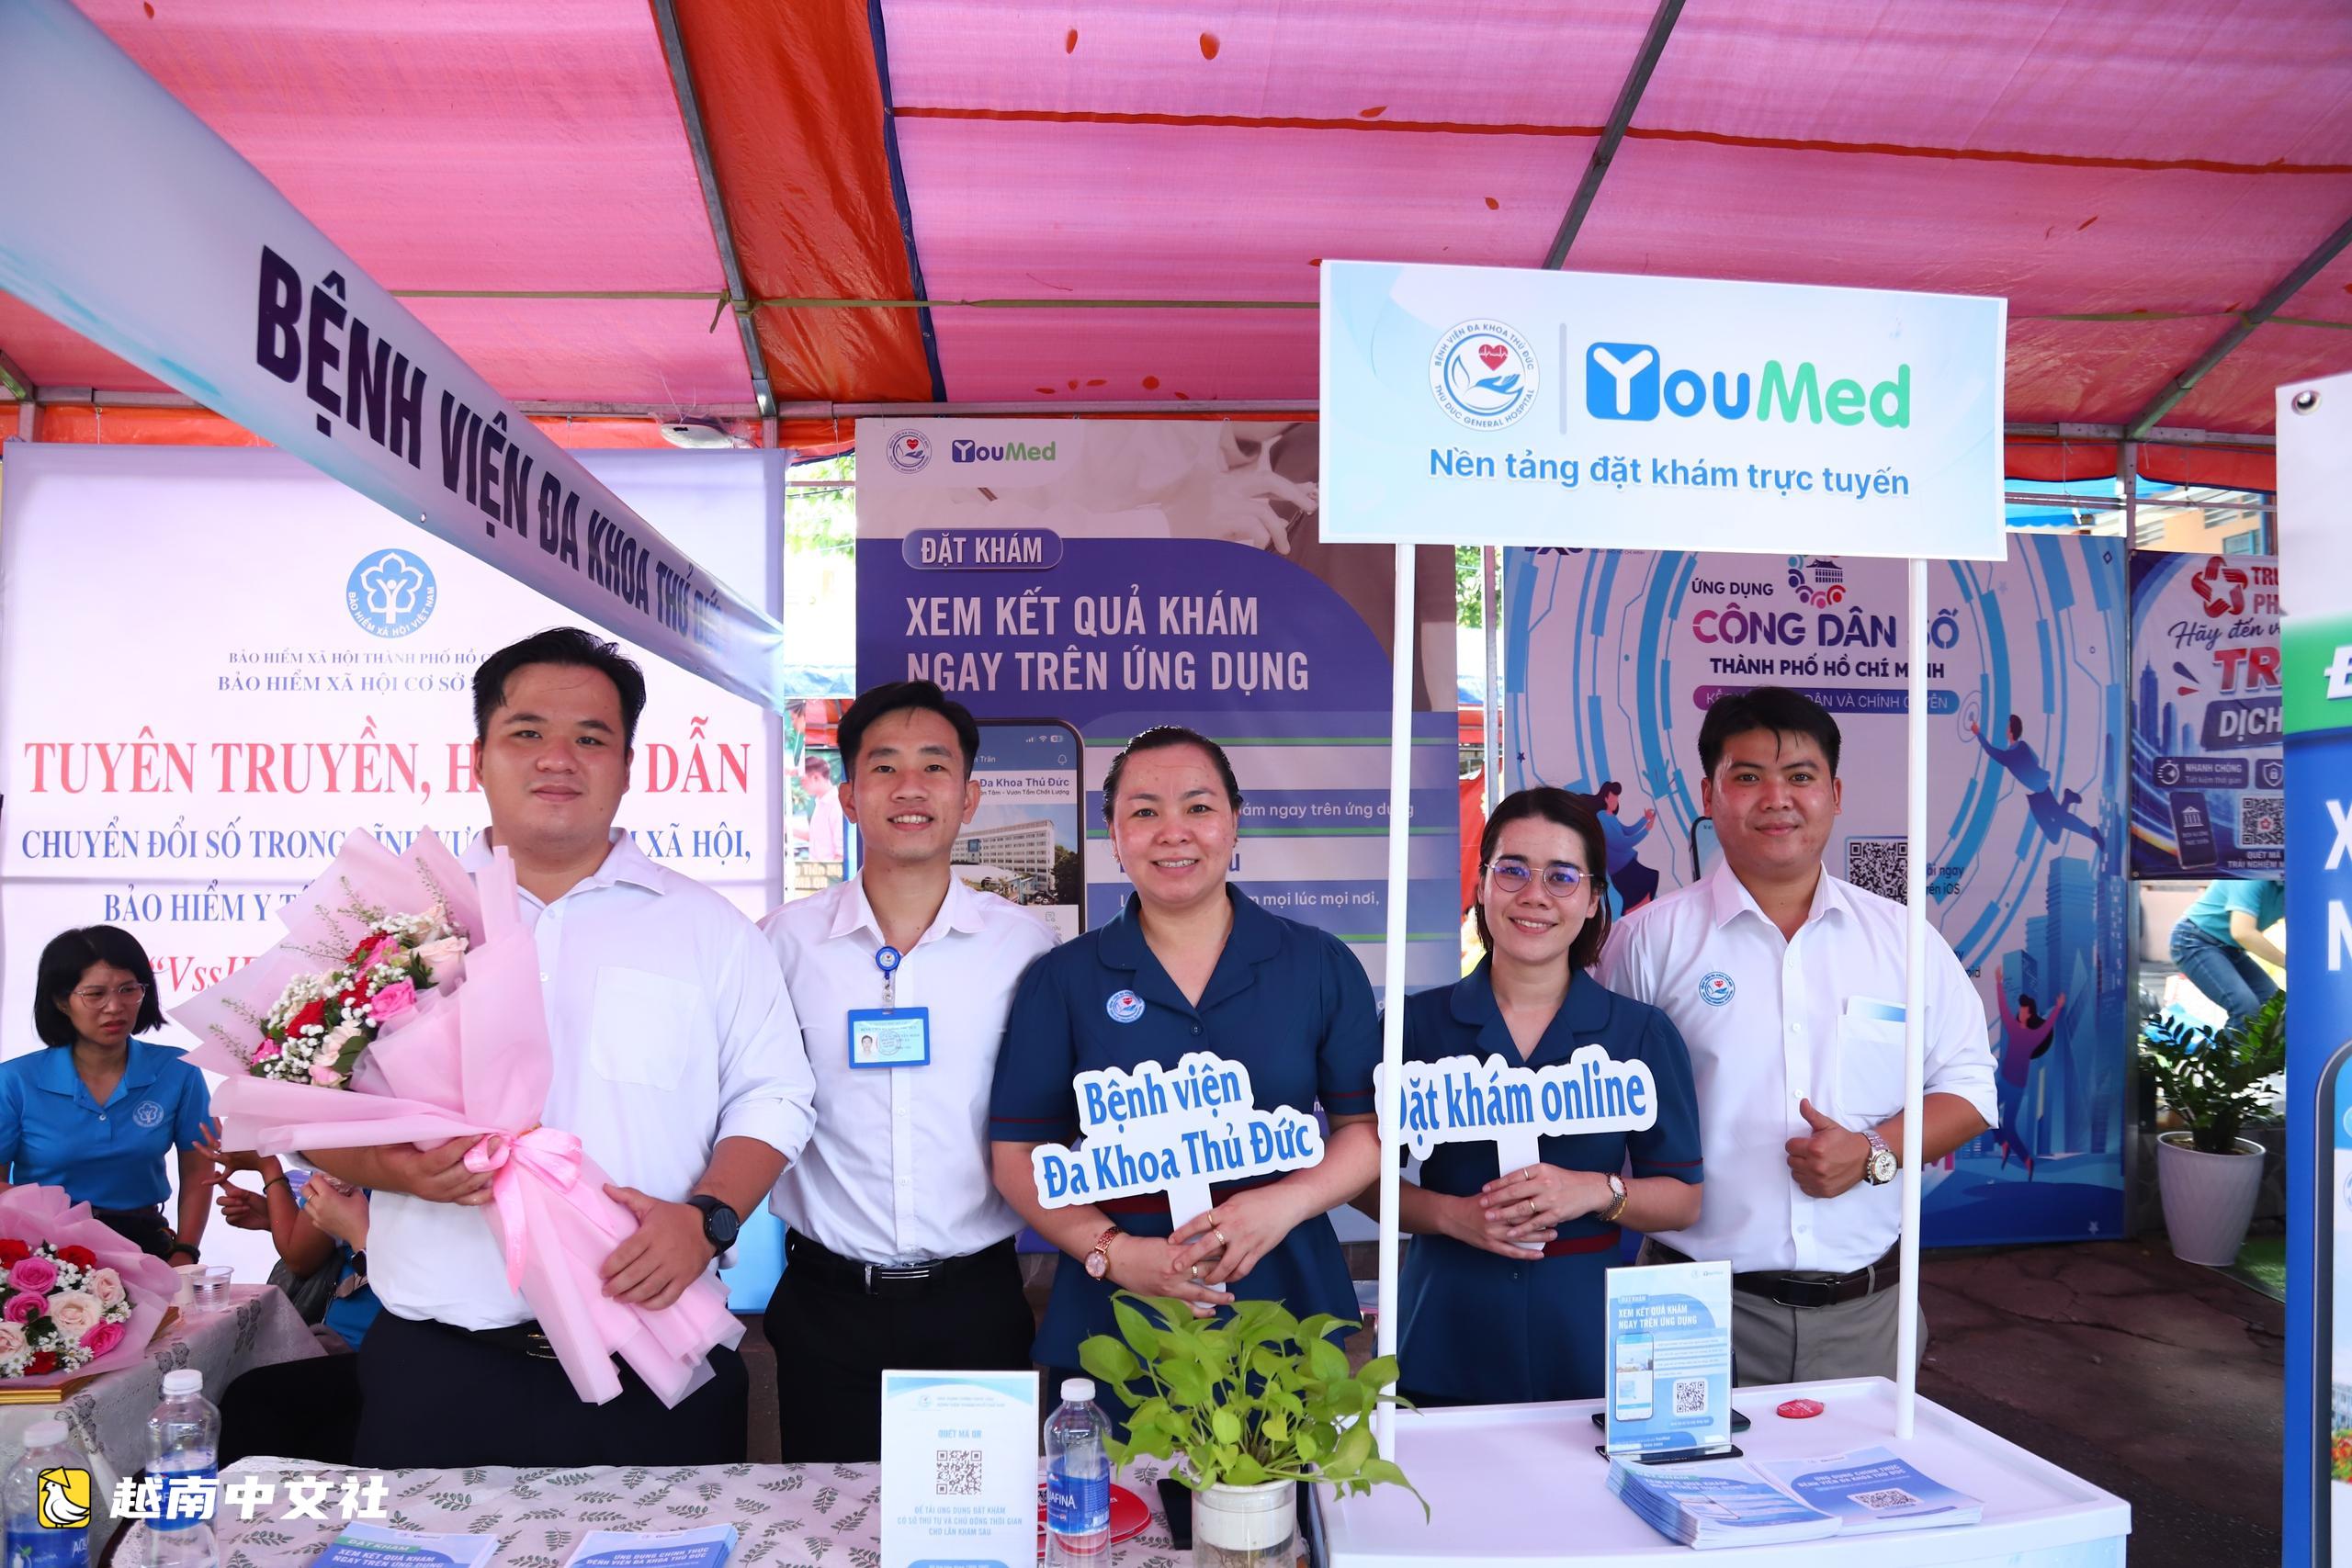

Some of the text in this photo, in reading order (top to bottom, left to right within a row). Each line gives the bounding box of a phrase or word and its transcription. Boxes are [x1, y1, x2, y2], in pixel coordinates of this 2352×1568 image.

[1483, 323, 1508, 337] KHOA
[1586, 342, 1911, 429] YouMed
[1505, 389, 1534, 423] HOSPITAL
[257, 244, 427, 469] BỆNH
[441, 389, 535, 539] VIỆN
[538, 470, 581, 571] ĐA
[588, 509, 650, 615] KHOA
[952, 439, 1056, 463] YouMed
[1429, 446, 1910, 499] Nền tảng đặt khám trực tuyến
[921, 532, 1043, 567] ĐẶT KHÁM
[424, 585, 435, 606] NAM
[1692, 578, 1773, 598] ỨNG DỤNG
[906, 582, 1259, 637] XEM KẾT QUẢ KHÁM
[1692, 602, 1960, 649] CÔNG DÂN Ố
[2168, 617, 2263, 650] Hãy đến
[230, 649, 260, 663] BẢO
[263, 646, 303, 663] HIỂM
[307, 649, 327, 663] XÃ
[331, 649, 359, 667] HỘI
[363, 649, 415, 663] THÀNH
[420, 648, 450, 663] PHỐ
[454, 647, 476, 663] HỒ
[906, 644, 1309, 696] NGAY TRÊN ỨNG DỤNG
[1710, 654, 1774, 675] THÀNH
[1780, 653, 1818, 676] PHỐ
[1824, 653, 1850, 676] HỒ
[1856, 658, 1890, 678] CHÍ
[218, 671, 260, 692] BẢO
[266, 670, 320, 692] HIỂM
[326, 672, 355, 692] XÃ
[361, 674, 399, 695] HỘI
[404, 674, 434, 692] CƠ
[438, 672, 467, 692] SỞ
[1838, 691, 1856, 708] VÀ
[1860, 691, 1900, 709] CHÍNH
[24, 726, 198, 795] TUYÊN
[211, 715, 430, 805] TRUYỀN,
[645, 716, 752, 795] DẪN
[996, 778, 1023, 787] Khoa
[1025, 777, 1046, 787] Thủ
[1047, 777, 1069, 787] Đức
[1270, 805, 1307, 819] ngay
[1311, 802, 1341, 816] trên
[1345, 801, 1374, 819] ứng
[22, 816, 346, 859] CHUYỂN ĐỔI SỐ TRONG
[647, 823, 684, 858] XÃ
[693, 821, 752, 864] HỘI,
[1939, 867, 1964, 879] ngay
[104, 884, 162, 922] BẢO
[171, 879, 244, 922] HIỂM
[255, 893, 272, 922] Y
[1262, 891, 1380, 909] mọi lúc mọi nơi,
[1084, 1063, 1242, 1134] Bệnh viện
[1444, 1069, 1535, 1129] khám
[1542, 1060, 1647, 1122] online
[1043, 1117, 1314, 1200] Đa Khoa Thủ Đức
